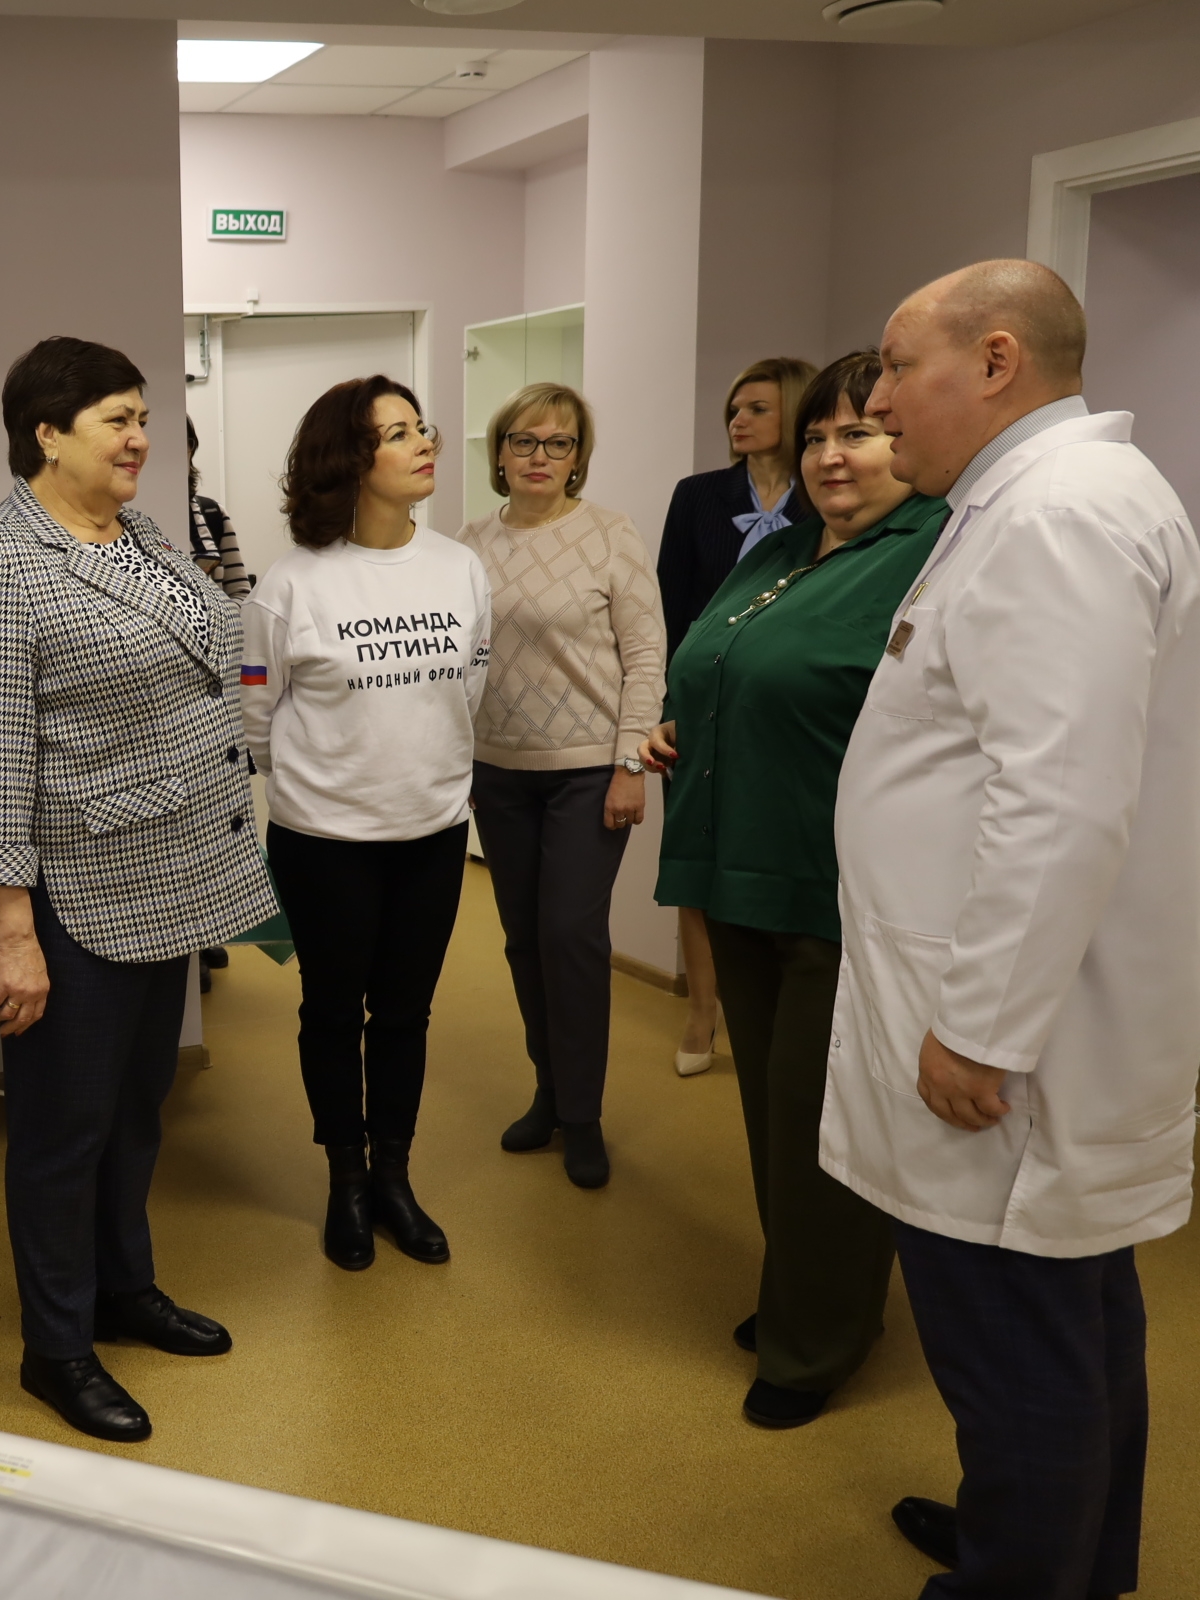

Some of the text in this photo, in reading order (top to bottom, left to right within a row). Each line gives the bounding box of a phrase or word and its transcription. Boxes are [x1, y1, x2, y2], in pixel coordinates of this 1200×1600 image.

[215, 213, 282, 233] ВЫХОД
[336, 611, 463, 641] КОМАНДА
[356, 635, 459, 663] ПУТИНА
[347, 666, 465, 690] НАРОДНЫЙ ФРОН
